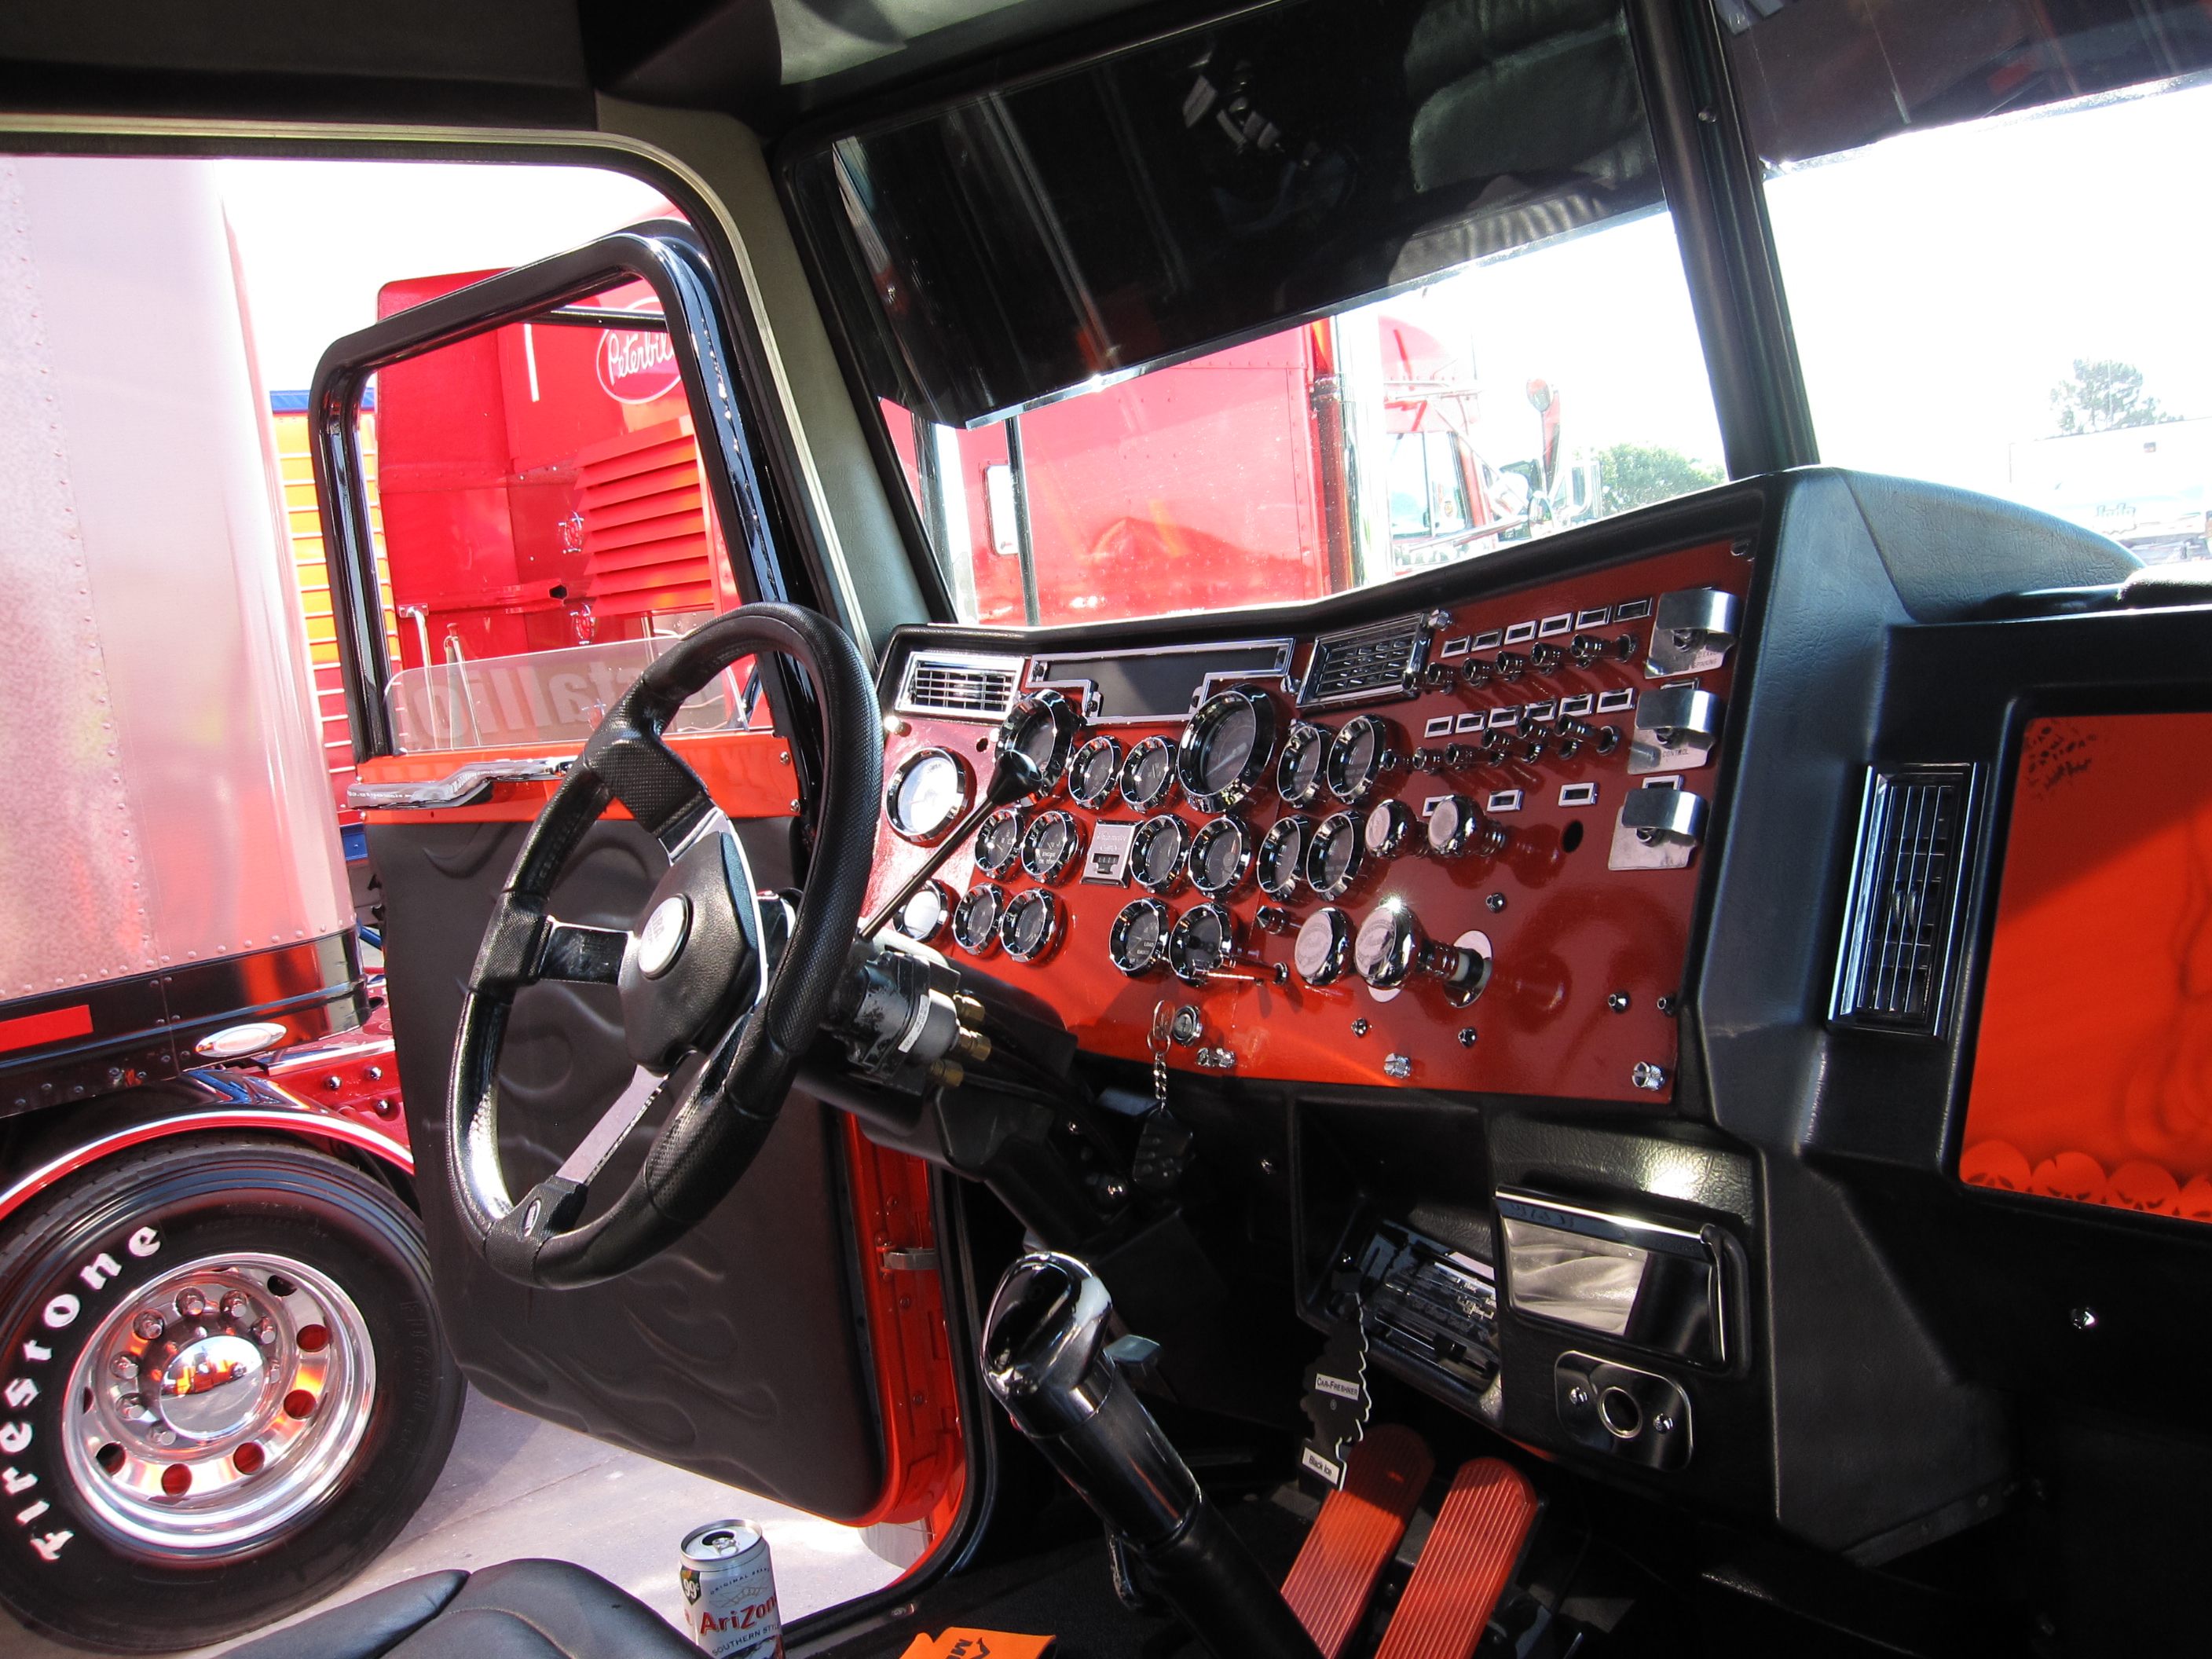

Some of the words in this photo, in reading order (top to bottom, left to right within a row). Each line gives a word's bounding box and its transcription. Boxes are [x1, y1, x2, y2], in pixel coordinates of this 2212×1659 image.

[608, 331, 676, 386] Peterbil
[0, 1225, 162, 1562] Firestone
[1317, 1376, 1358, 1397] CAR-FRESHNER
[1309, 1455, 1324, 1471] Black
[1324, 1465, 1333, 1477] Ice
[709, 1574, 749, 1595] ORIGINAL
[700, 1593, 778, 1636] AriZon
[712, 1630, 760, 1657] SOUTHERN
